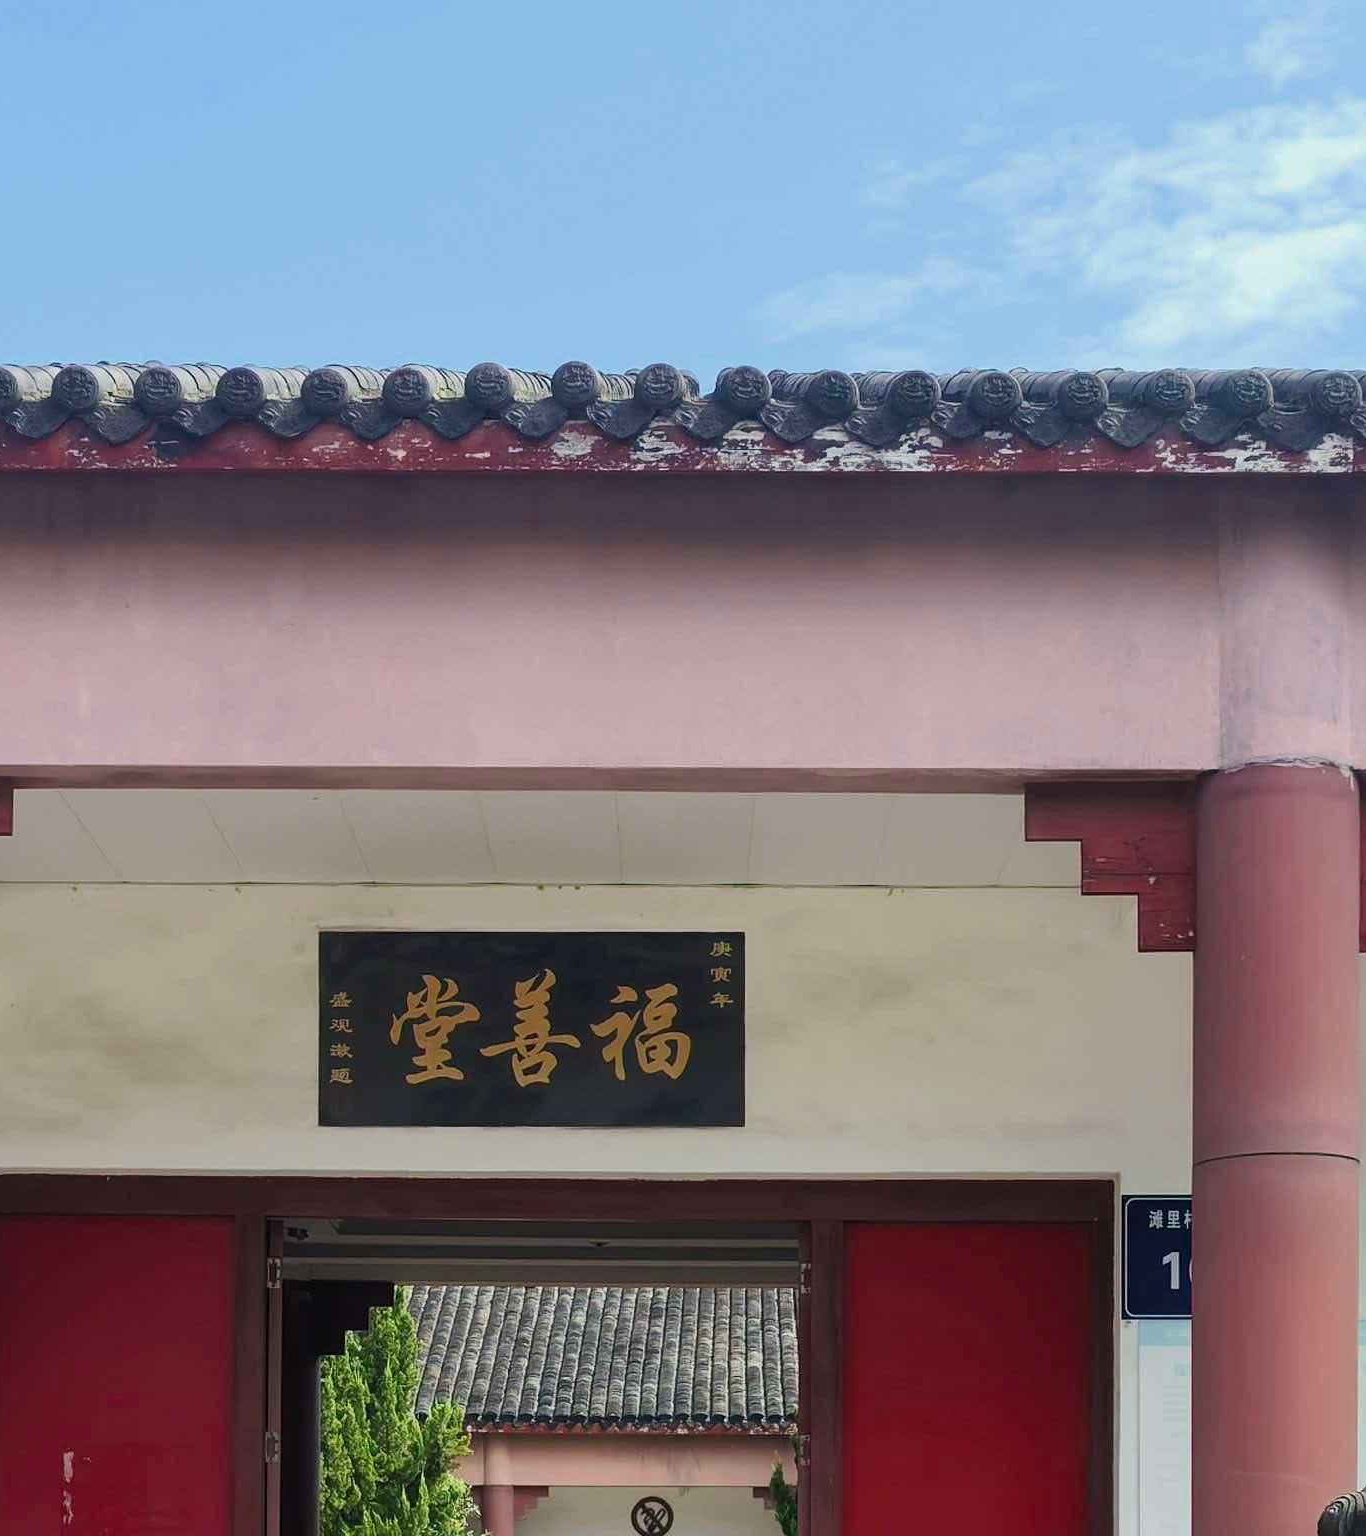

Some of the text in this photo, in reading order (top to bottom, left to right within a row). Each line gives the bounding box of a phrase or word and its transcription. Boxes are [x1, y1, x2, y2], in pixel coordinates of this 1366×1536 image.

[389, 968, 692, 1088] 福善堂
[1162, 1251, 1193, 1290] 1
